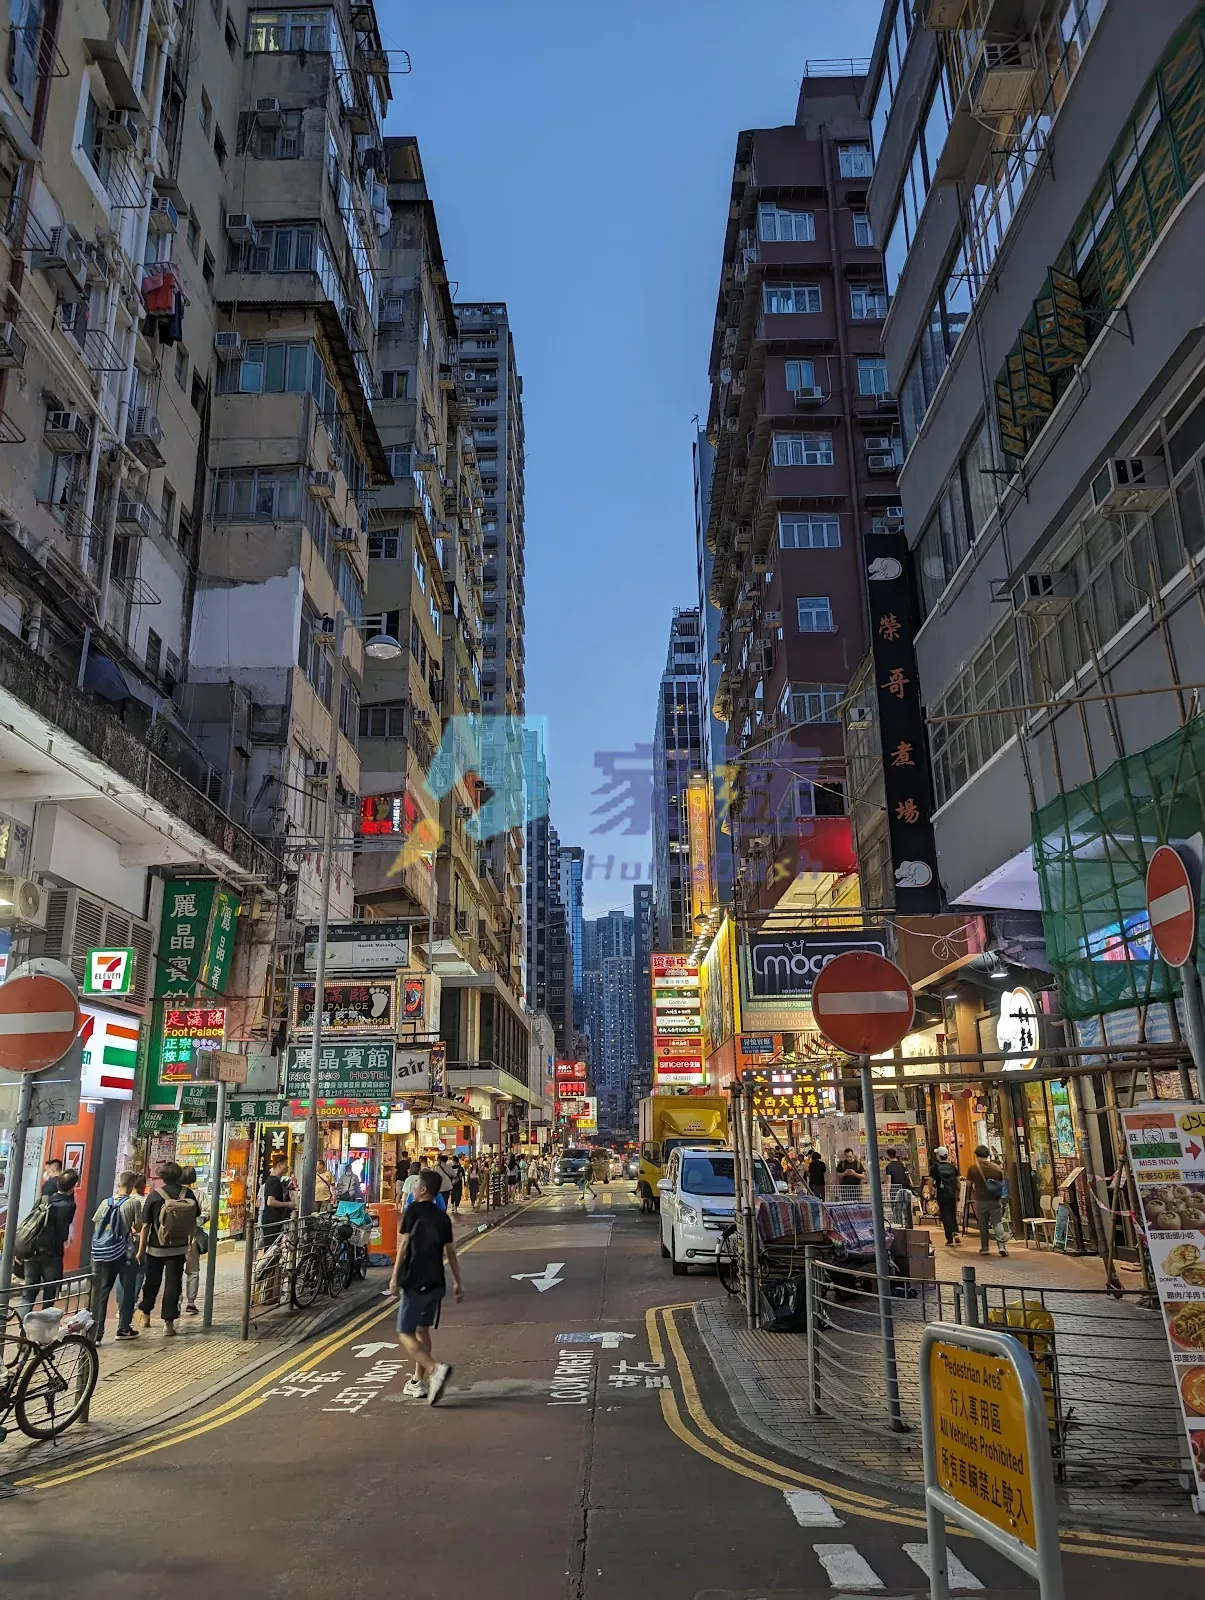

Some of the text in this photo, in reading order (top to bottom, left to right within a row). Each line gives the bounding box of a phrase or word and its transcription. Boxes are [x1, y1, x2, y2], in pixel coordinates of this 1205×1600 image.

[878, 612, 920, 825] 榮哥煮場
[162, 893, 198, 1009] 麗晶賓館
[327, 1002, 369, 1012] PALACE
[165, 1027, 225, 1037] Foot Palace
[165, 1038, 192, 1049] 正宗
[163, 1050, 191, 1062] 按摩
[291, 1047, 390, 1069] 麗晶賓館
[659, 1061, 689, 1069] sincere
[350, 1070, 391, 1080] HOTEL
[395, 1060, 425, 1080] air
[320, 1107, 343, 1115] BODY
[343, 1106, 380, 1115] MASSAGE
[554, 1349, 593, 1374] RIGHT
[944, 1354, 1002, 1392] Pedestrian Area
[322, 1359, 408, 1413] LOOK LEFT
[547, 1375, 590, 1405] LOOK
[949, 1387, 1002, 1435] 行人專用區
[939, 1415, 1024, 1476] All Vehicles Prohibited
[941, 1446, 1029, 1525] 所有車輛禁止駛入
